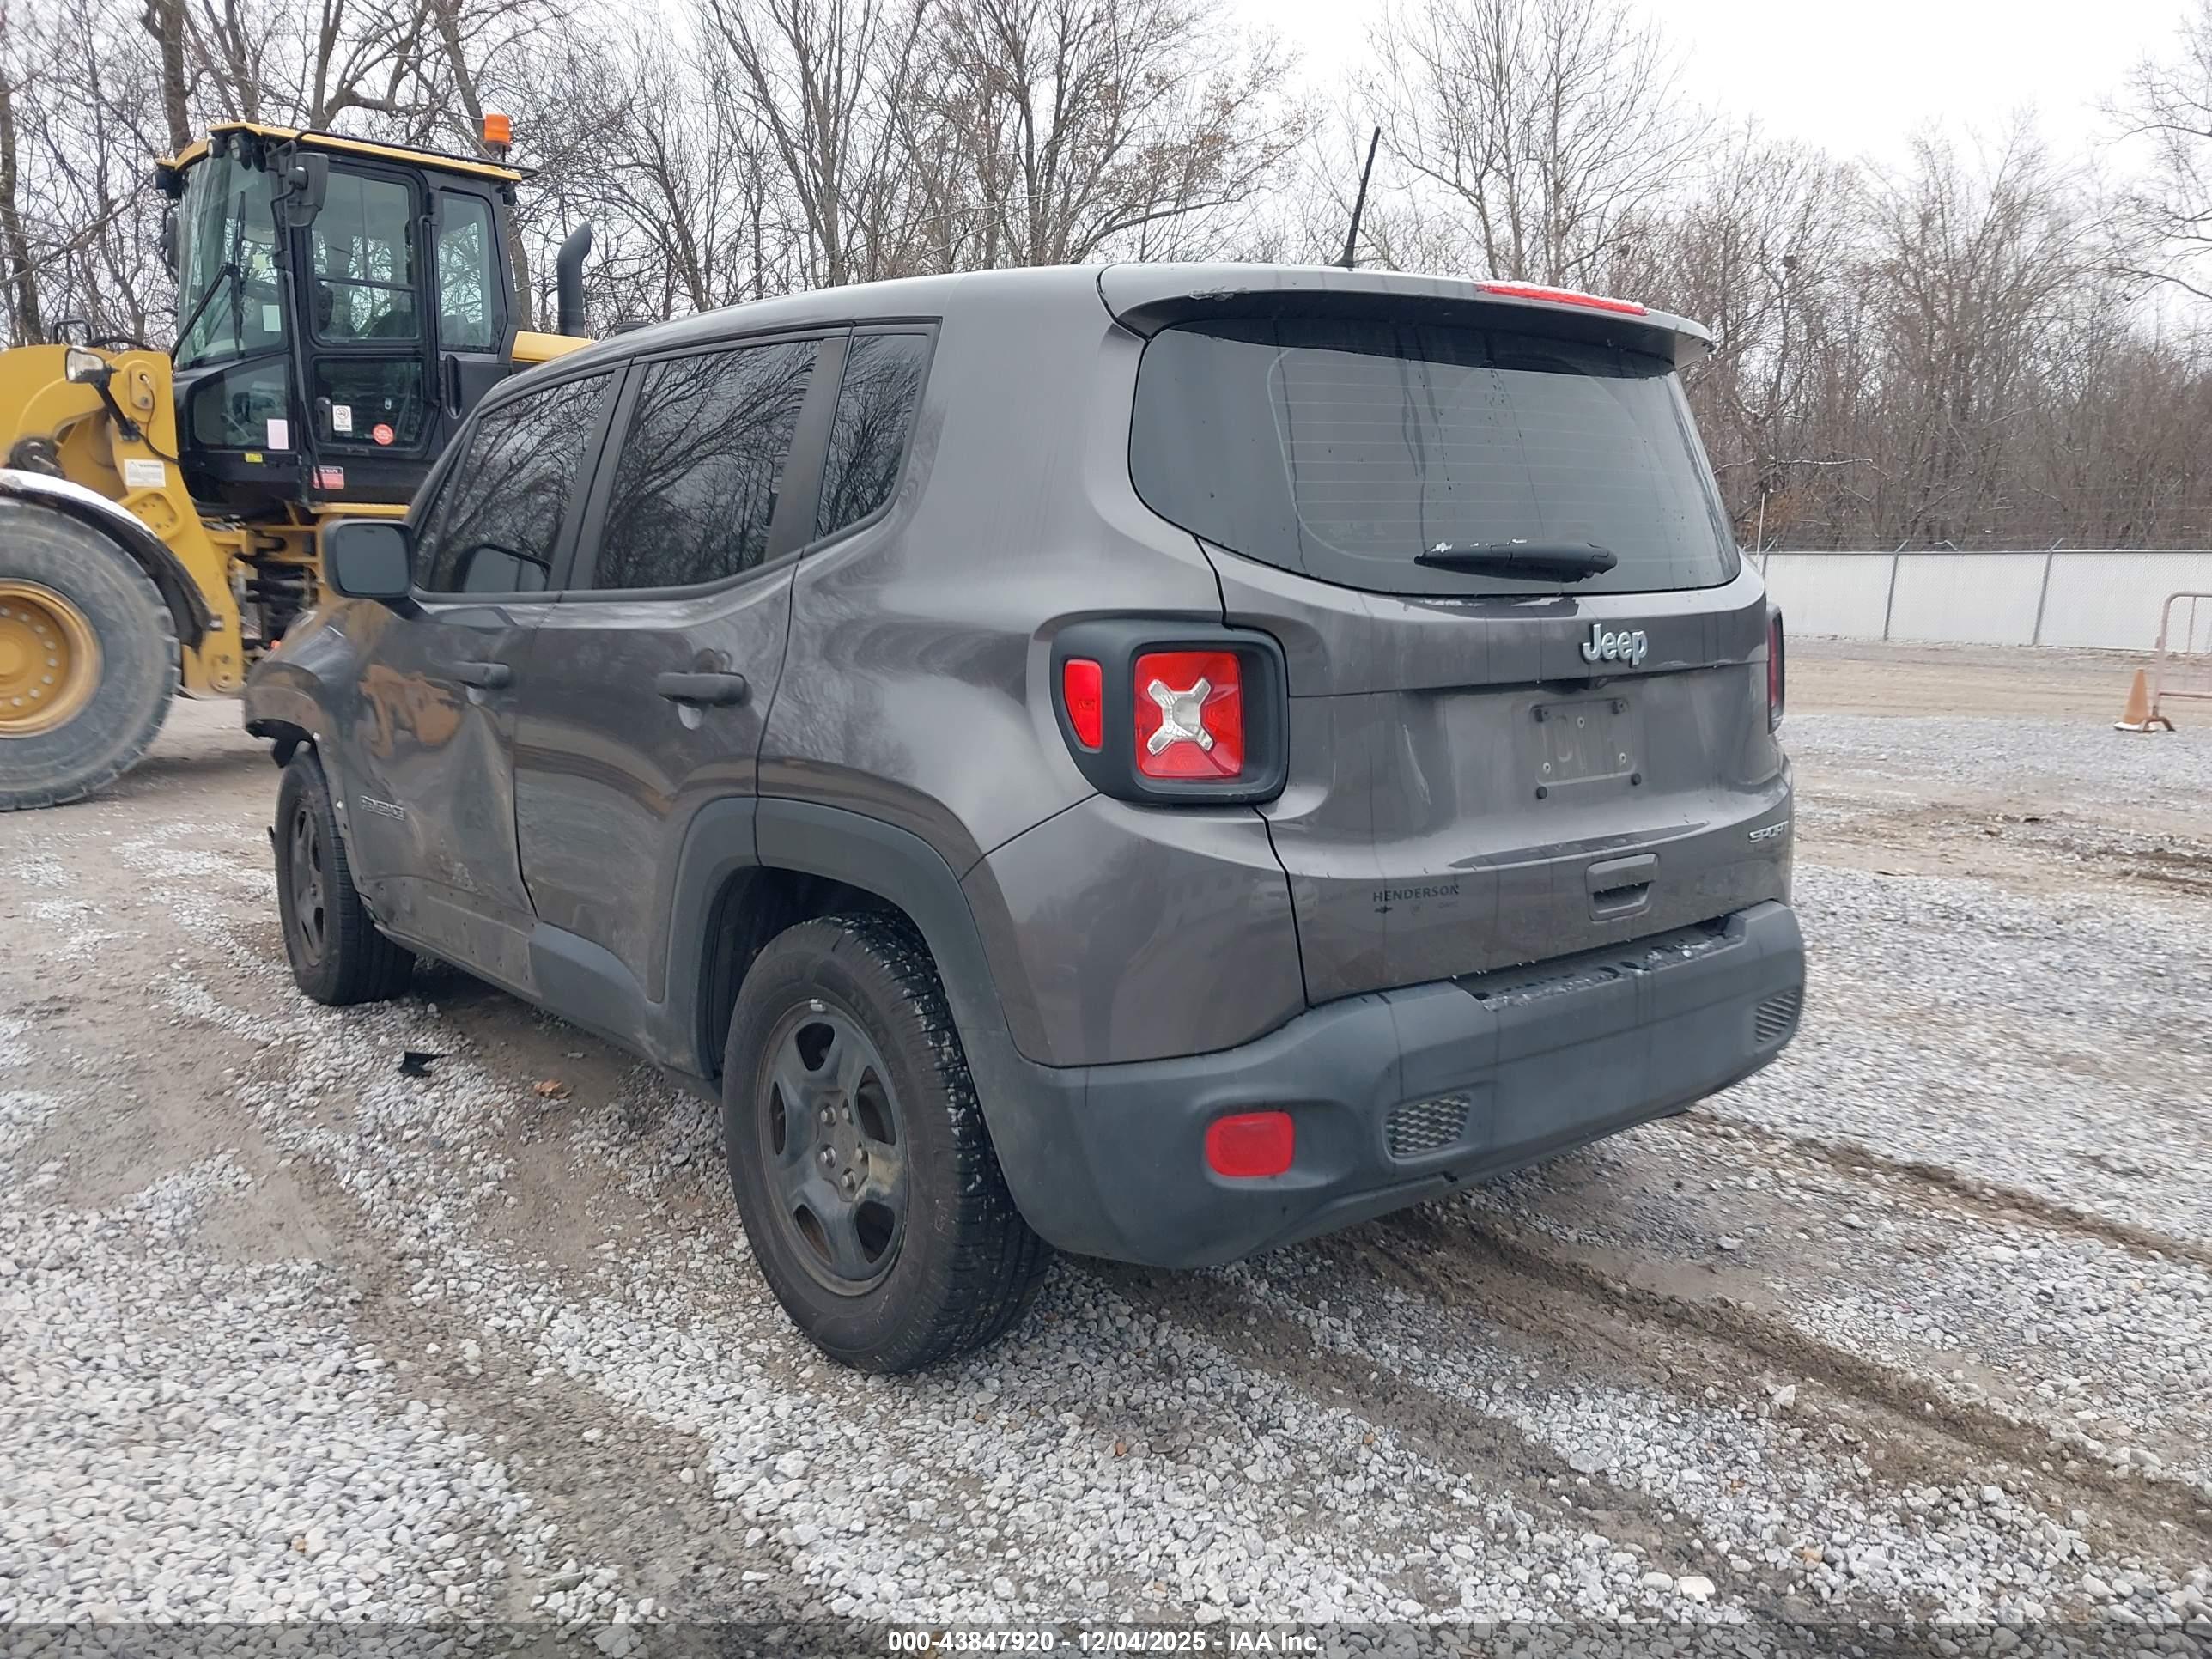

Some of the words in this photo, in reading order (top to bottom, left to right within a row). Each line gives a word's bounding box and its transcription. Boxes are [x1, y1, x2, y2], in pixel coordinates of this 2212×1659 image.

[1581, 623, 1648, 667] Jeep
[1748, 820, 1790, 843] SPORT
[1373, 884, 1459, 902] HENDERSON
